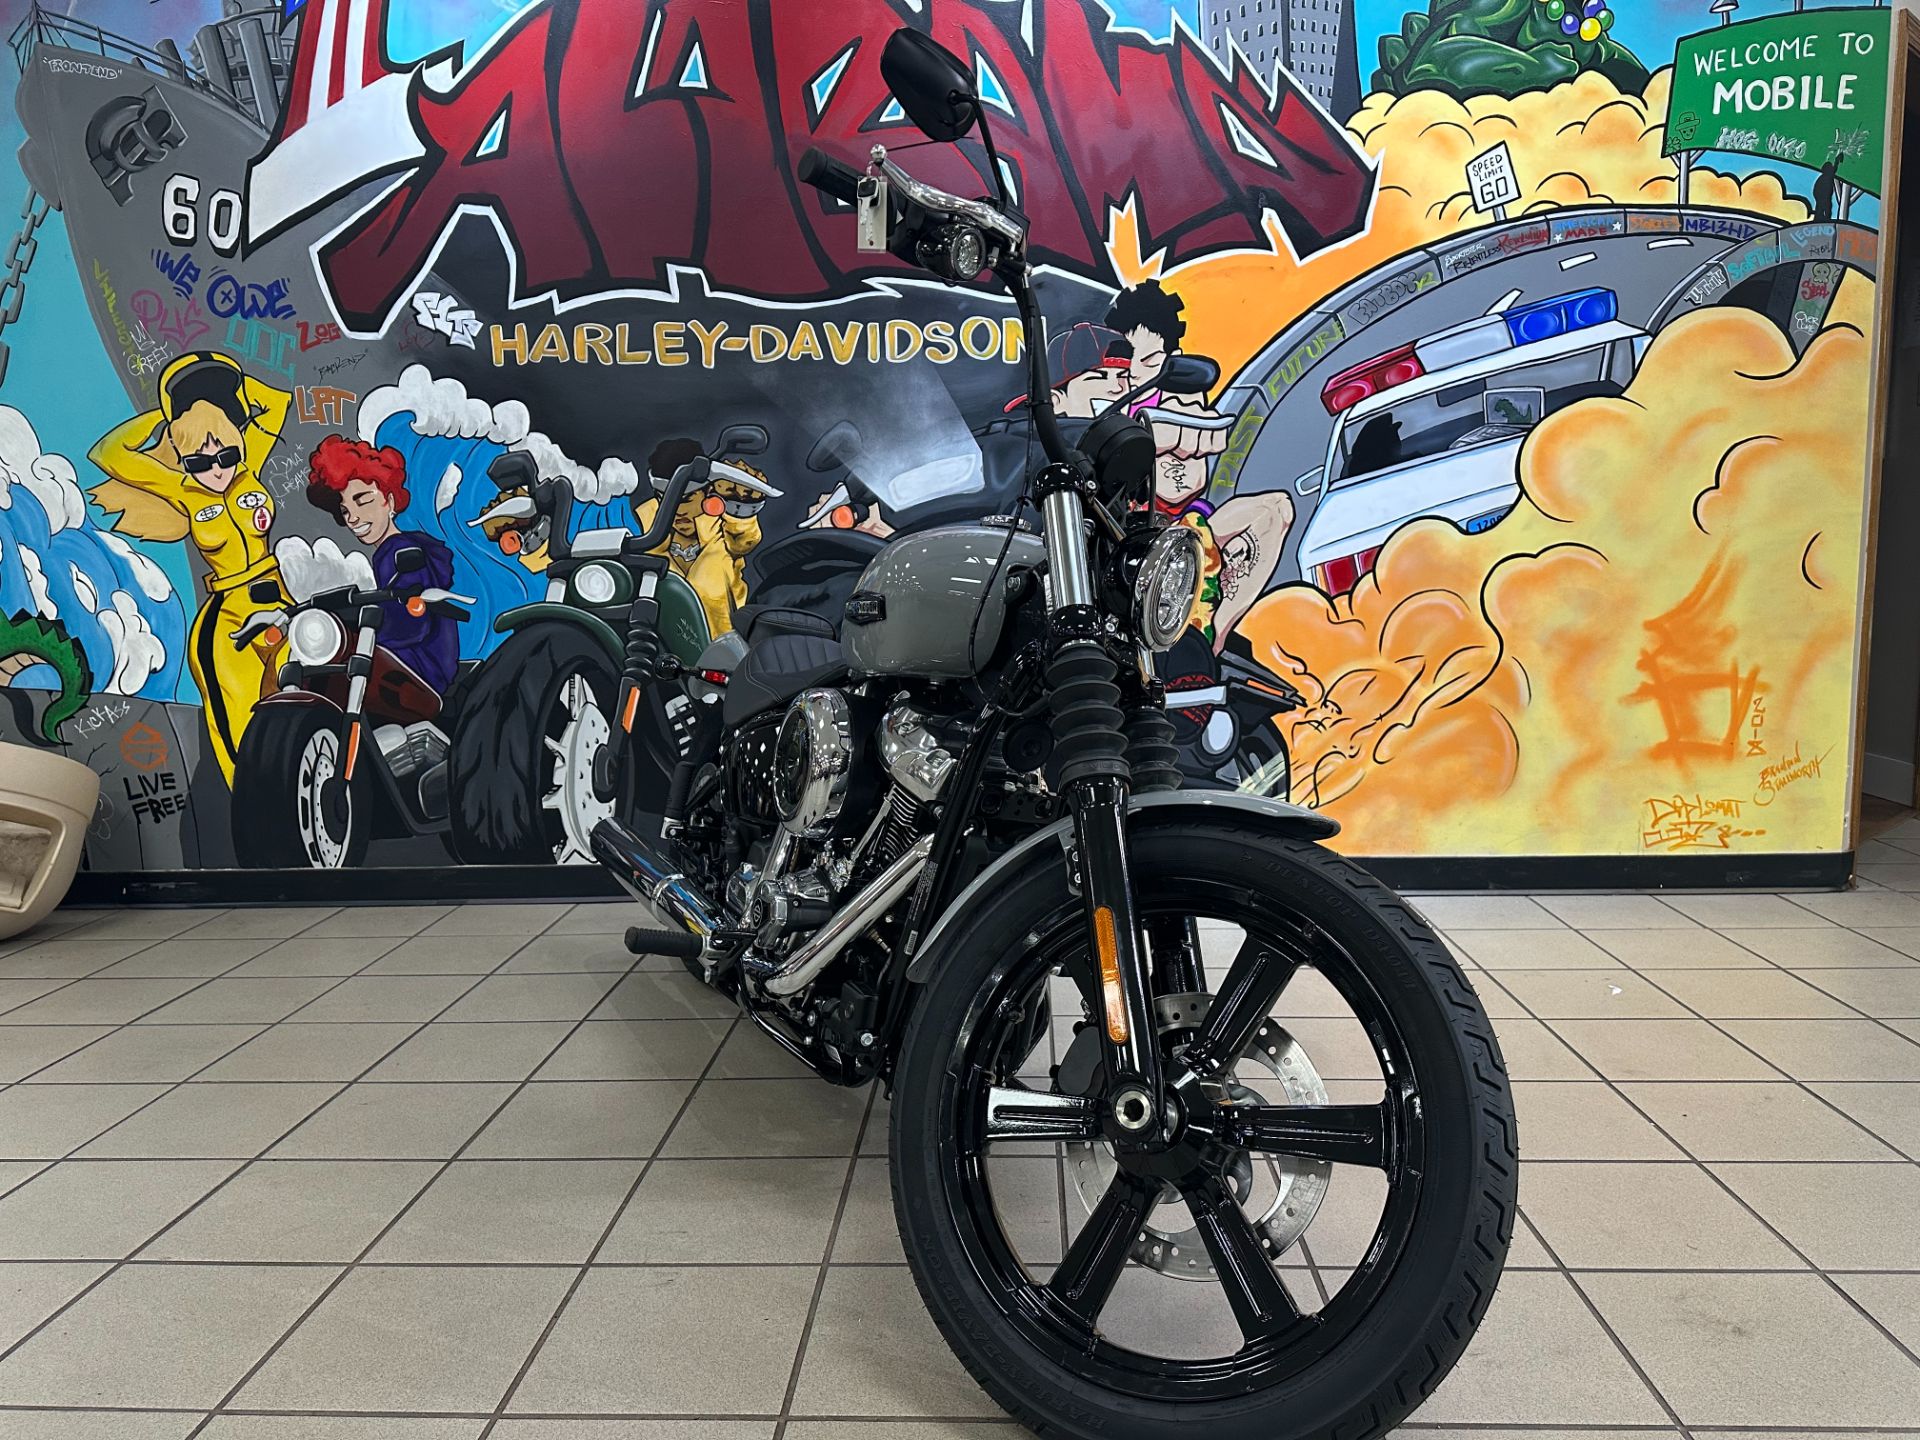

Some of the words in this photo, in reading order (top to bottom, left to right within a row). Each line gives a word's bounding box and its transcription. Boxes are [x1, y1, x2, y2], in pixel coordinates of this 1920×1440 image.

[1693, 34, 1819, 77] WELCOME
[1838, 32, 1874, 55] TO
[1712, 74, 1858, 115] MOBILE
[1472, 154, 1503, 177] SPEED
[1479, 165, 1504, 182] LIMIT
[162, 173, 243, 250] 60
[1565, 227, 1608, 239] MADE
[1790, 224, 1836, 249] LEGEND
[489, 316, 1048, 369] HARLEY-DAVIDSON
[1267, 314, 1346, 401] FUTURE
[1213, 403, 1264, 489] PAST
[122, 771, 177, 801] LIVE
[131, 793, 187, 825] FREE
